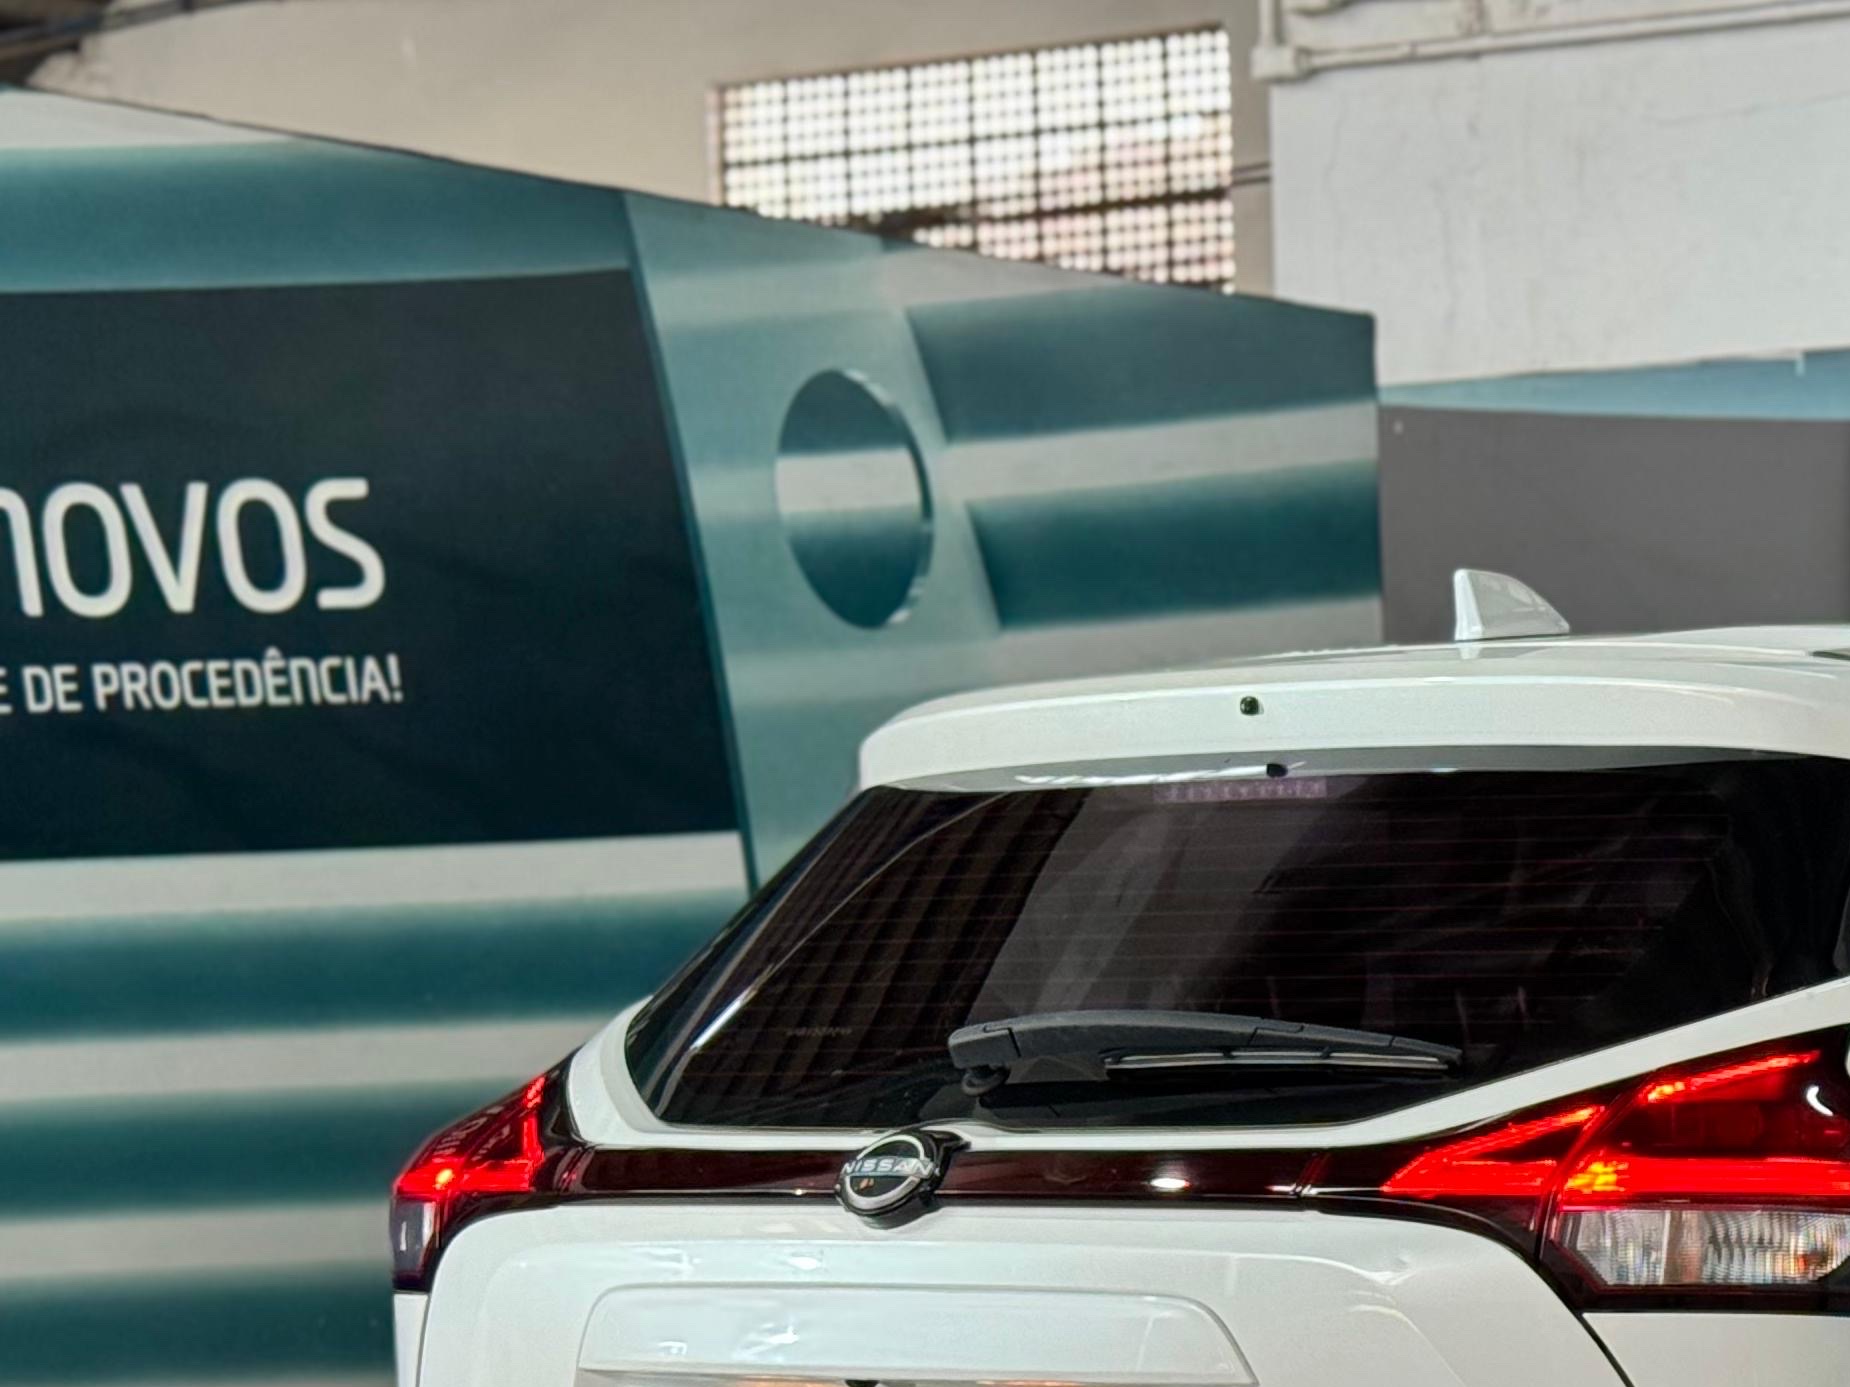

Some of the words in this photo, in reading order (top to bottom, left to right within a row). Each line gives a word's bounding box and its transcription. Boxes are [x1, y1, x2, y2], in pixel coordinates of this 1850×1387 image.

[22, 664, 83, 714] DE
[91, 646, 404, 711] PROCEDÊNCIA!
[840, 1157, 935, 1179] NISSAN
